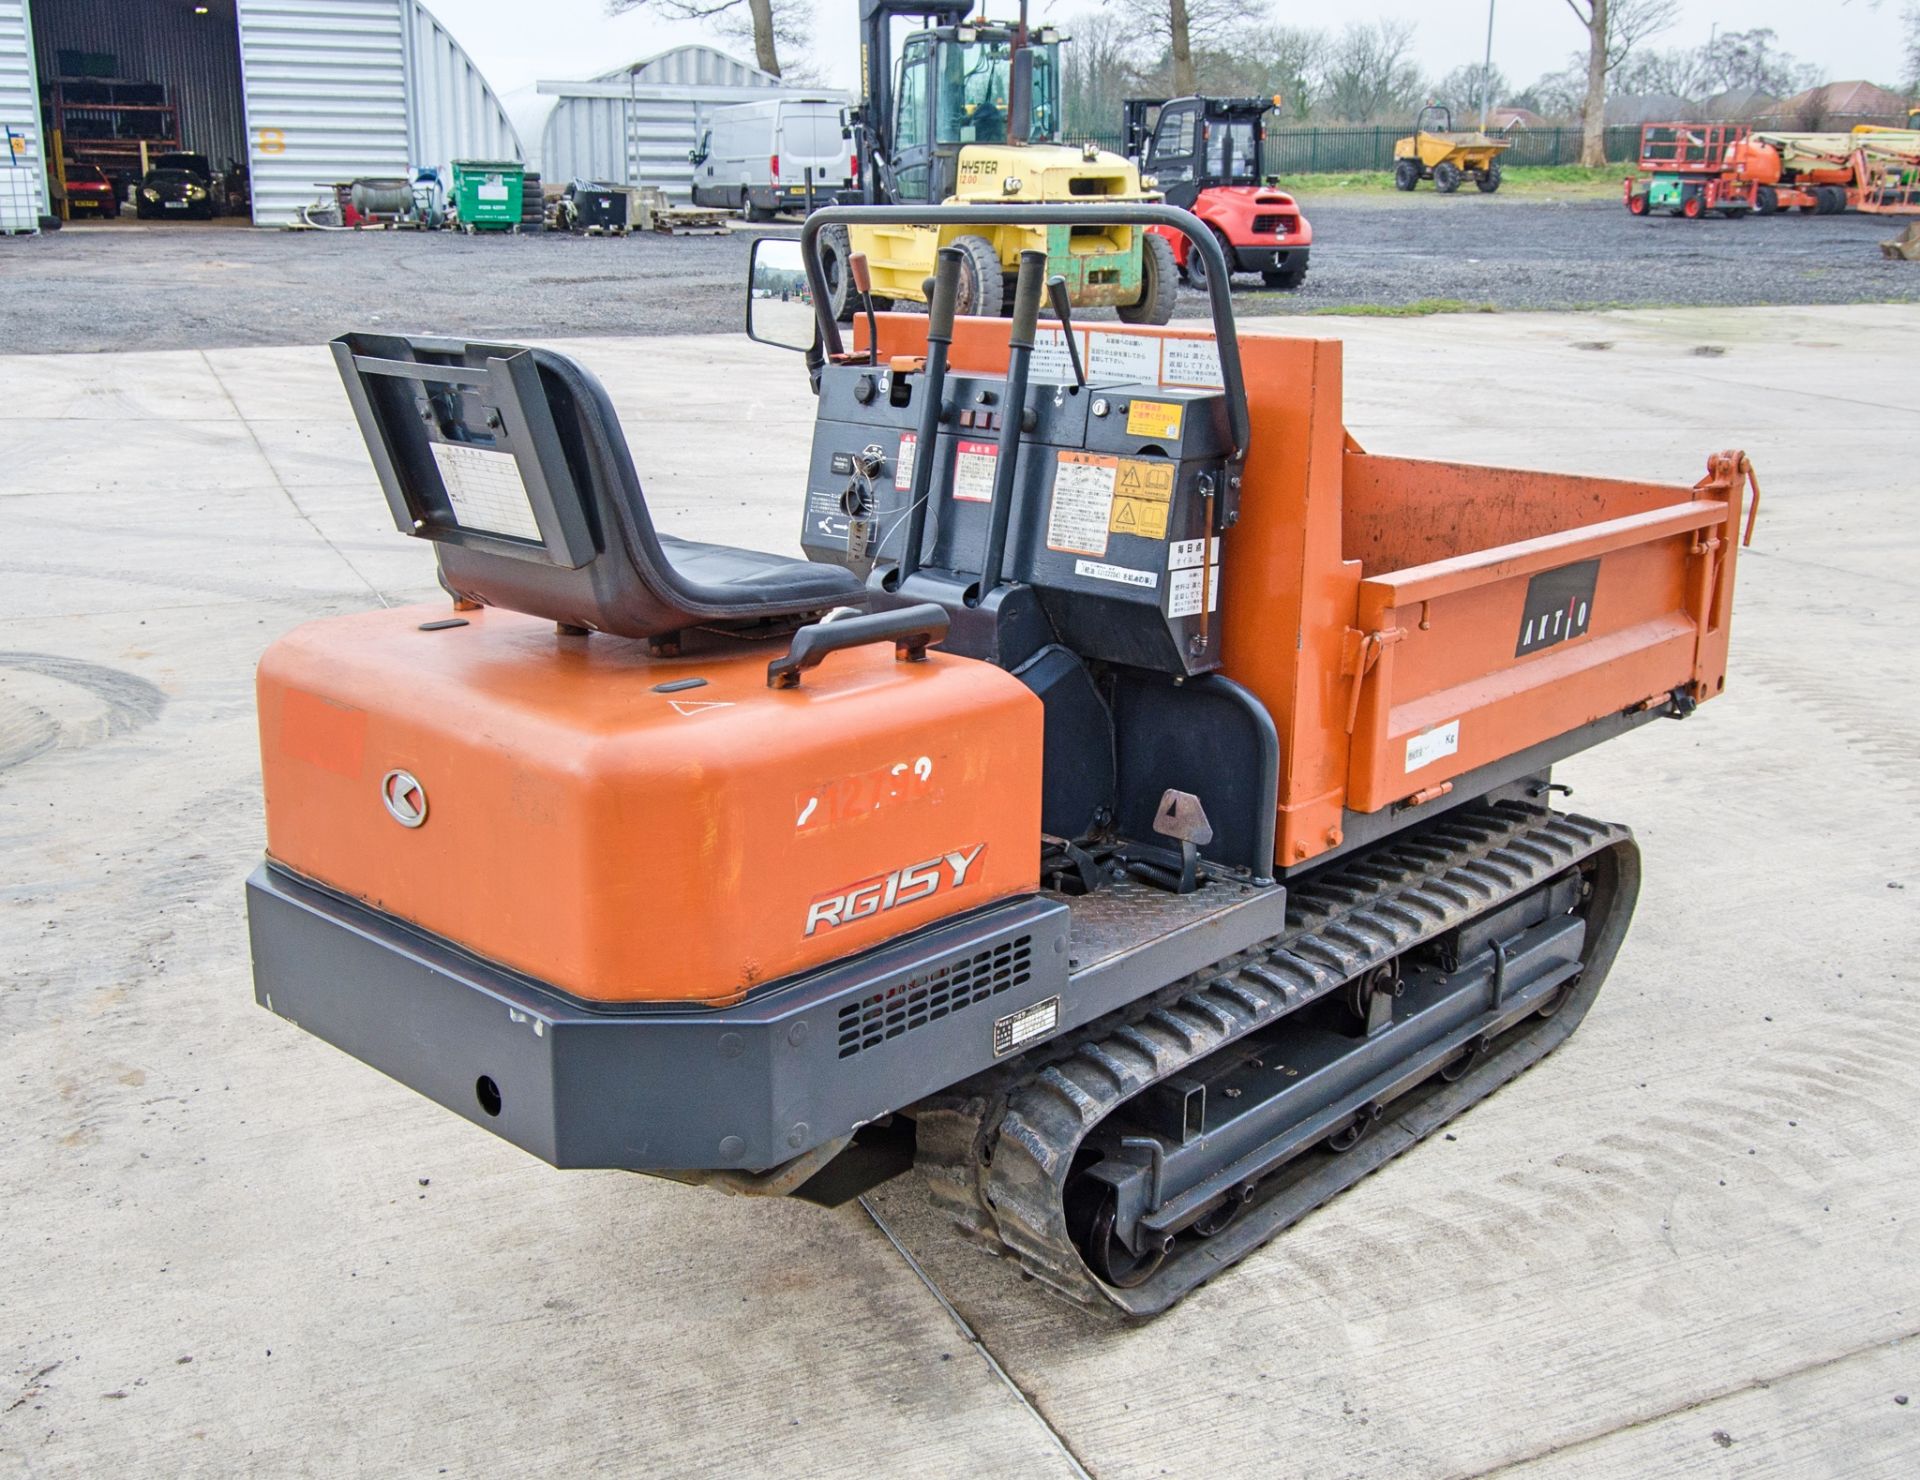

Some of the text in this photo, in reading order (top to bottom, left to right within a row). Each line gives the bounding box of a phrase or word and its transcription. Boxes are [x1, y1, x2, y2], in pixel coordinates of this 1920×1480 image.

[258, 128, 286, 154] 8
[960, 160, 998, 175] HYSTER
[803, 842, 986, 936] RG15Y
